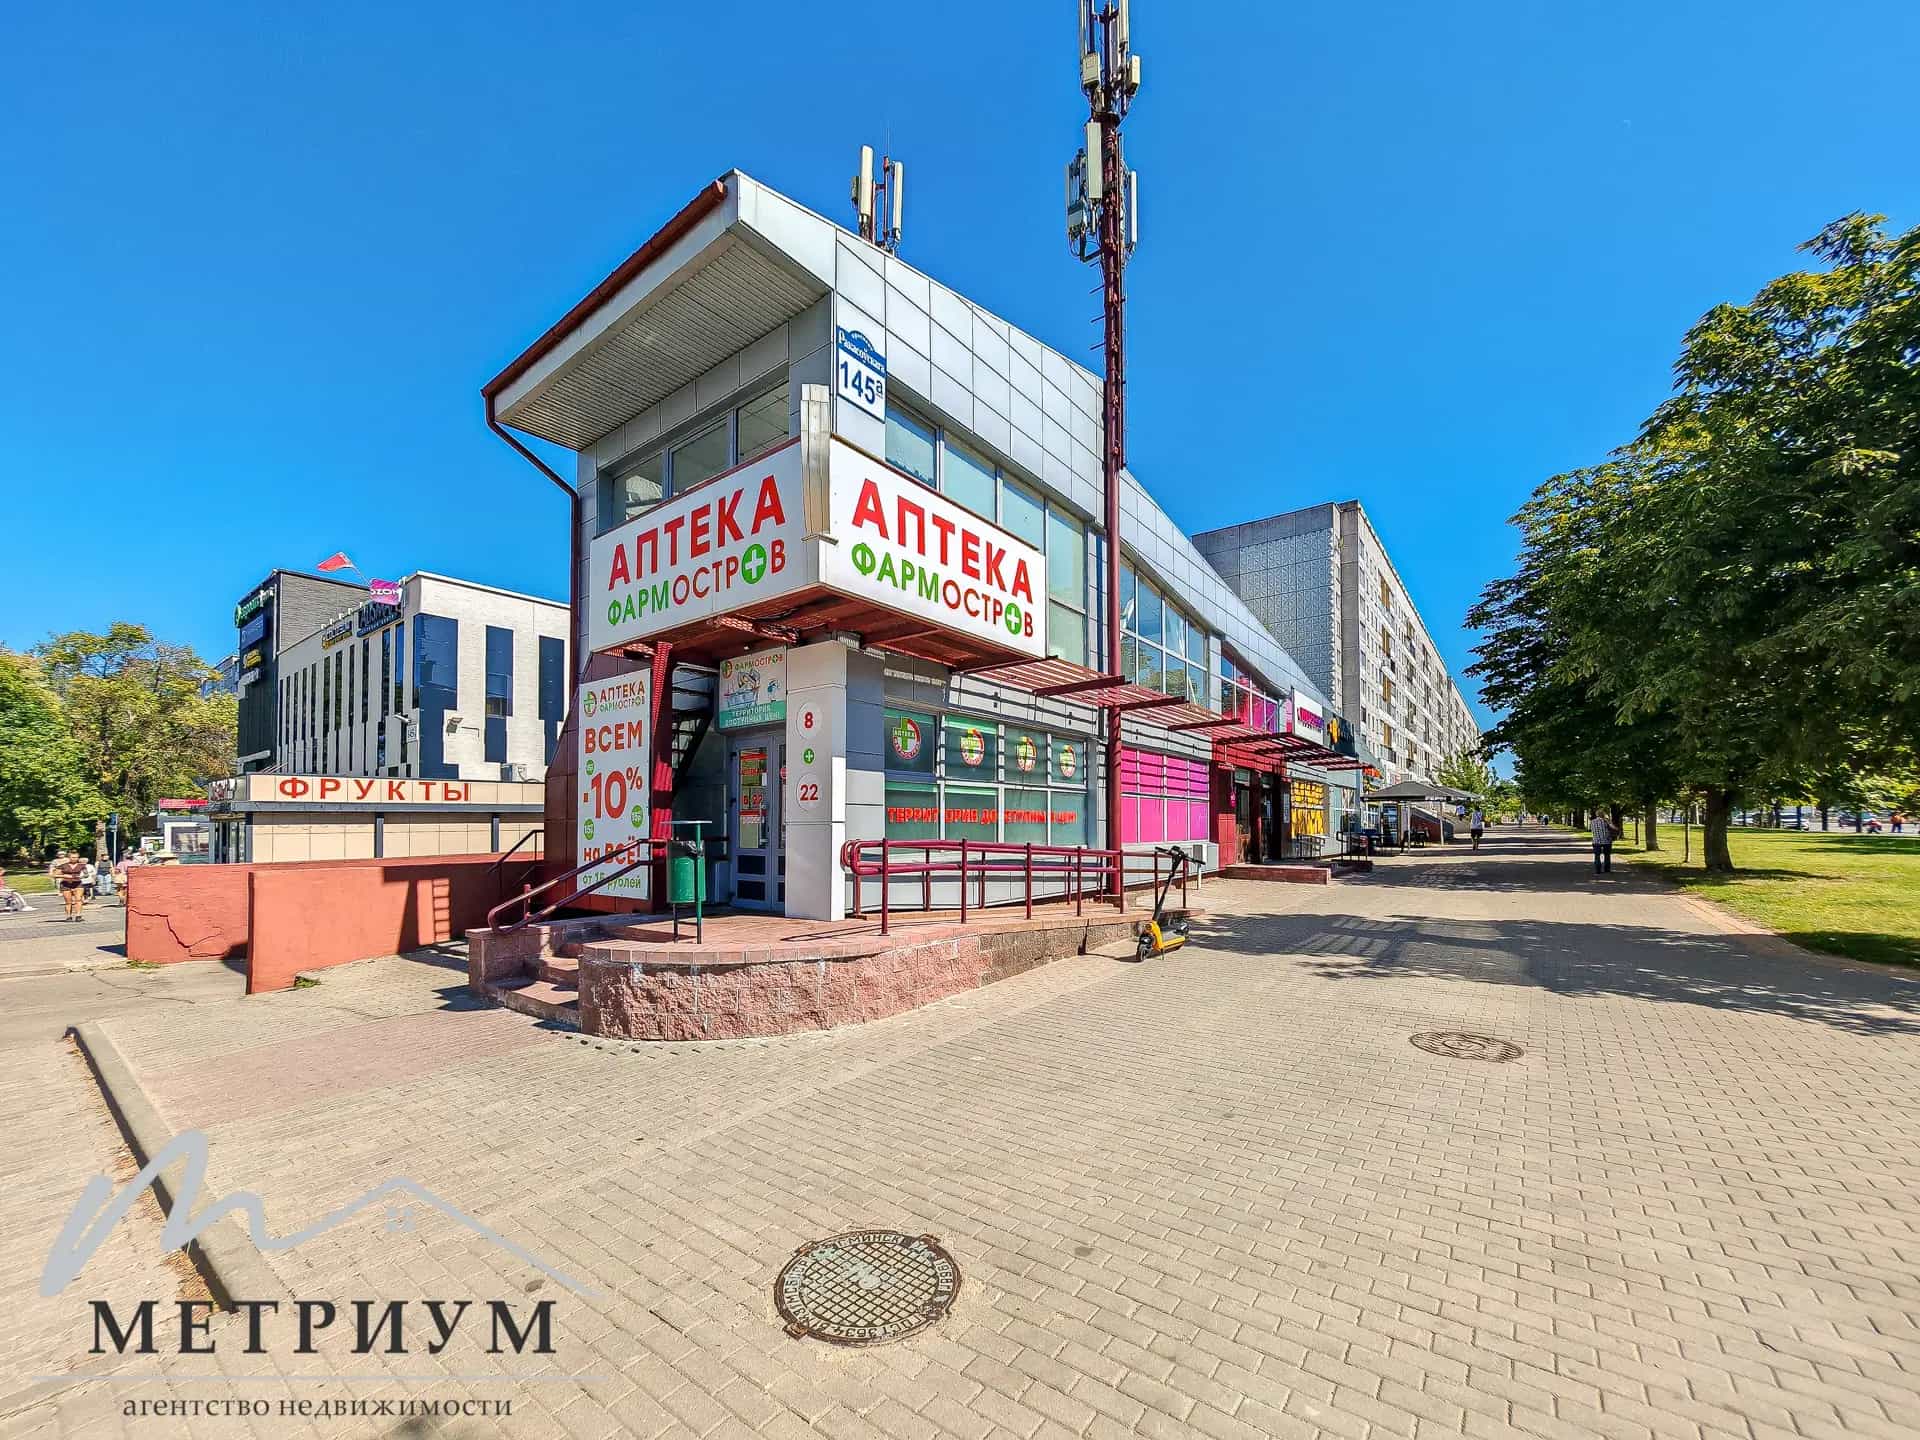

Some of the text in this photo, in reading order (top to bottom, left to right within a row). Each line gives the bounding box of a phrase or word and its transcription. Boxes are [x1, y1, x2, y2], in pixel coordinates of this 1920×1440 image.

[608, 474, 786, 592] АПТЕКА
[852, 478, 1034, 604] АПТЕКА
[607, 538, 787, 626] ФАРМОСТРОВ
[851, 542, 1034, 638] ФАРМОСТРОВ
[735, 654, 783, 671] ФАРМОСТРОВ
[600, 680, 645, 703] АПТЕКА
[600, 696, 645, 712] ФАРМОСТРОВ
[805, 712, 814, 728] 8
[585, 720, 643, 753] ВСЕМ
[279, 777, 469, 801] ФРУКТЫ
[583, 766, 643, 820] -10%
[801, 784, 819, 801] 22
[584, 848, 600, 862] на
[583, 875, 592, 885] от
